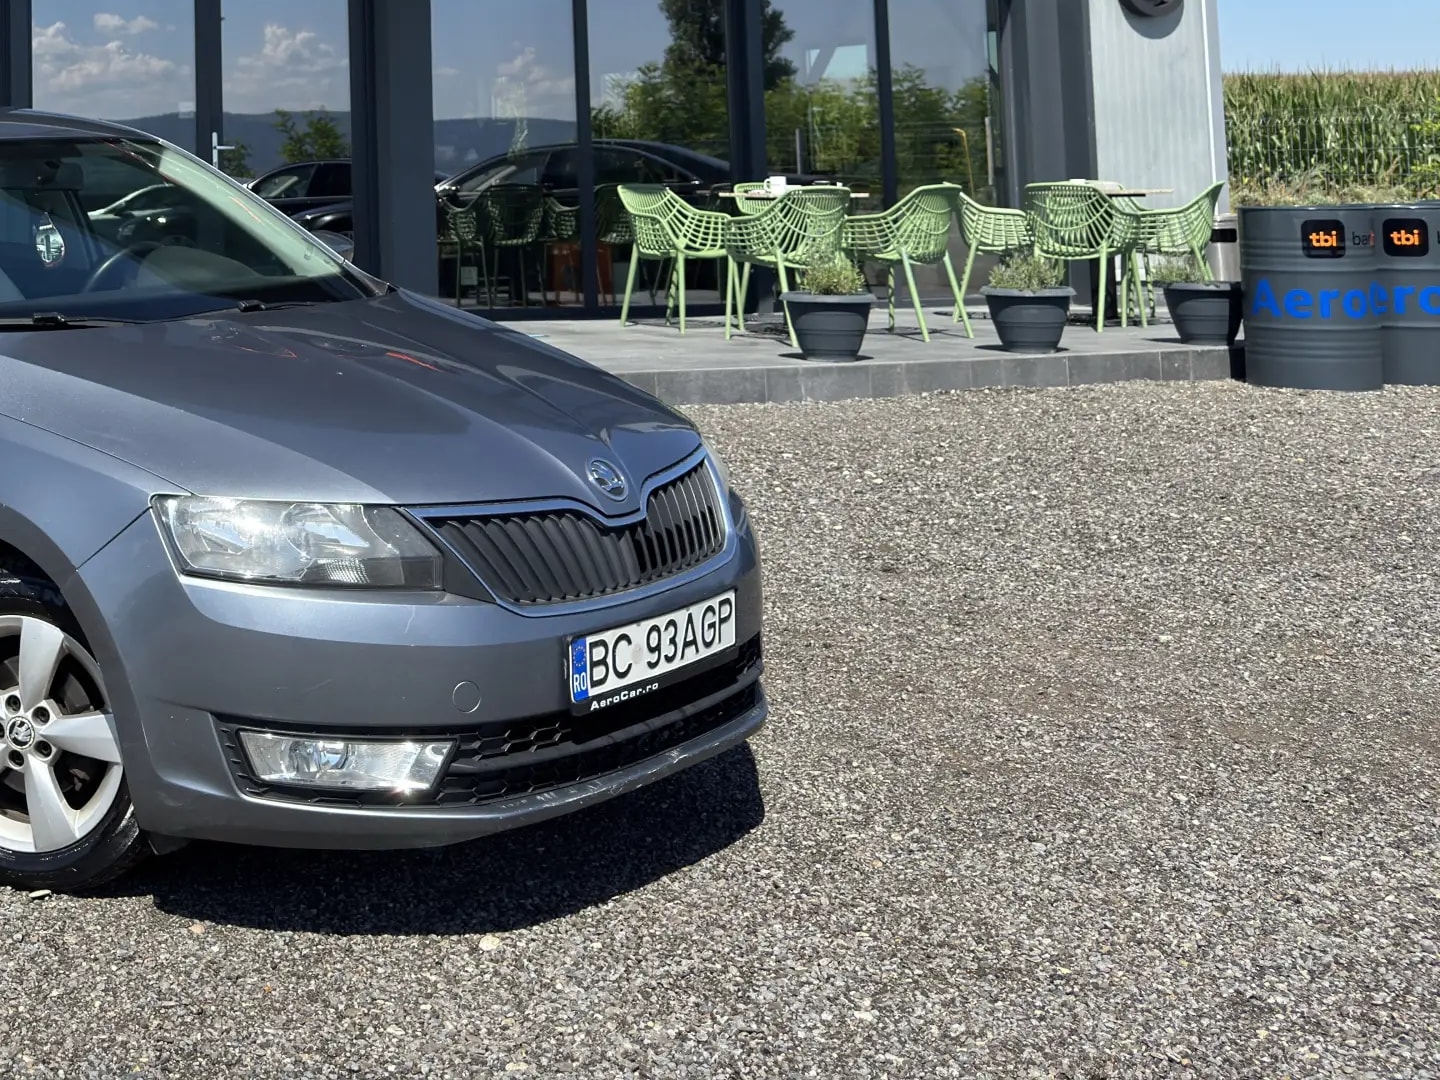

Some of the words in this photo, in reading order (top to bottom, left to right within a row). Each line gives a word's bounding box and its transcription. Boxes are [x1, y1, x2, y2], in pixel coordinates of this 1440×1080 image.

[1309, 230, 1337, 247] tbi
[1390, 229, 1419, 246] tbi
[588, 633, 633, 689] BC
[573, 671, 587, 693] RO
[590, 682, 659, 711] AeroCar.ro
